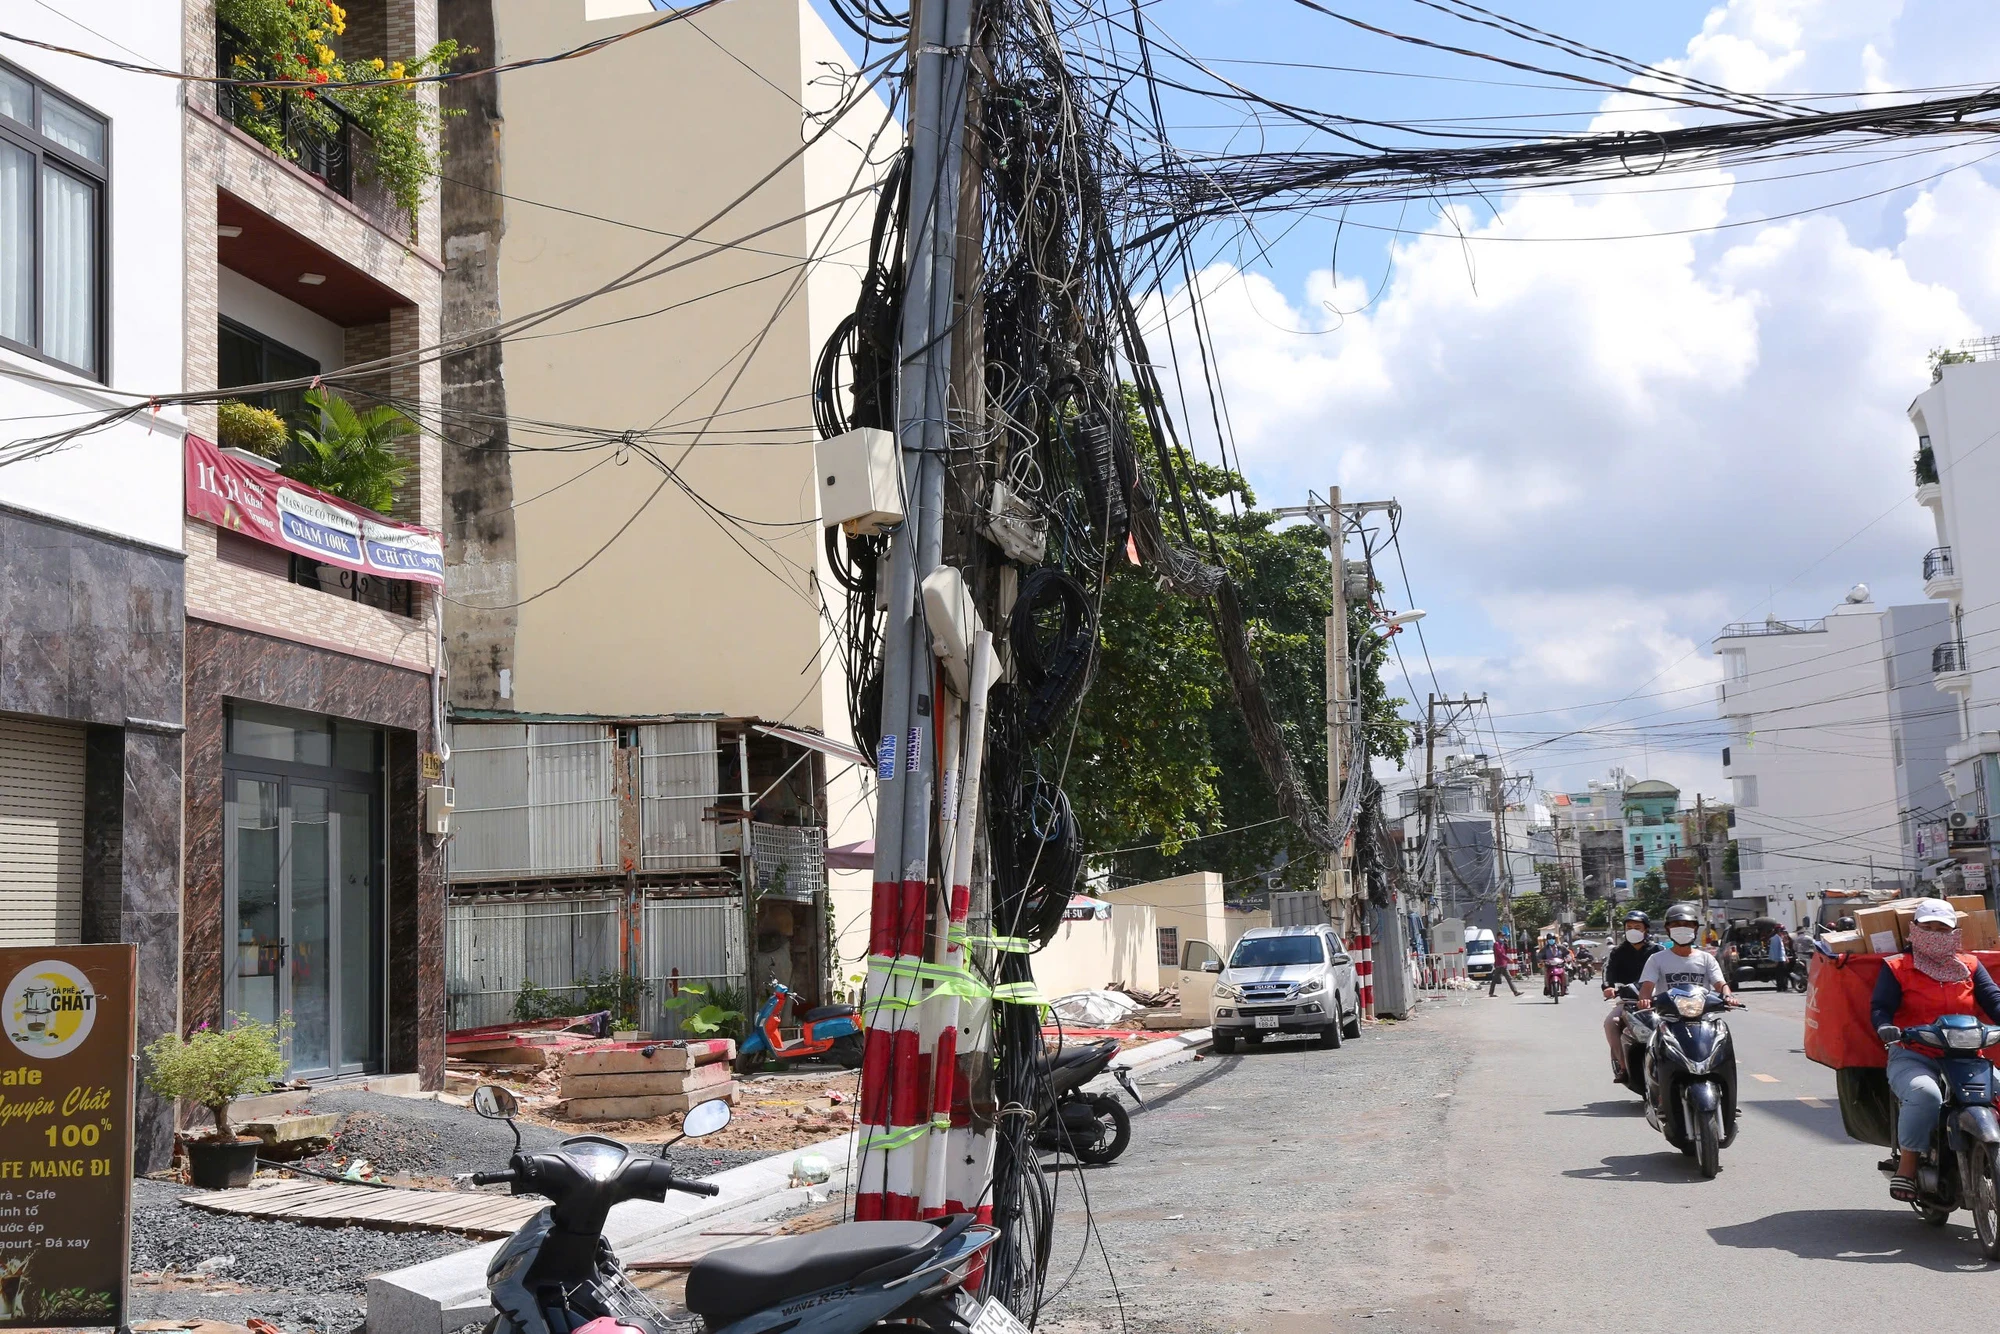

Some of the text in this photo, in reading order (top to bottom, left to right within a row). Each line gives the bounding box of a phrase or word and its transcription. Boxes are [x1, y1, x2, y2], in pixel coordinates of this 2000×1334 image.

[282, 495, 314, 516] MASSAGE
[290, 520, 323, 545] GIẢM
[324, 532, 351, 554] 100K
[376, 547, 400, 565] CHỈ
[421, 556, 442, 572] 99K
[424, 756, 438, 770] 416
[63, 986, 75, 994] PHÊ
[0, 1067, 42, 1085] afe
[62, 1086, 111, 1117] Chất
[0, 1159, 110, 1178] FE MANG ĐI
[0, 1190, 13, 1200] rà
[26, 1190, 56, 1200] Cafe
[0, 1204, 39, 1216] inh tố
[0, 1222, 44, 1234] ước ép
[0, 1239, 32, 1249] aourt
[45, 1238, 63, 1248] Đá
[67, 1238, 90, 1249] xay
[781, 1287, 857, 1316] WAVE RSX
